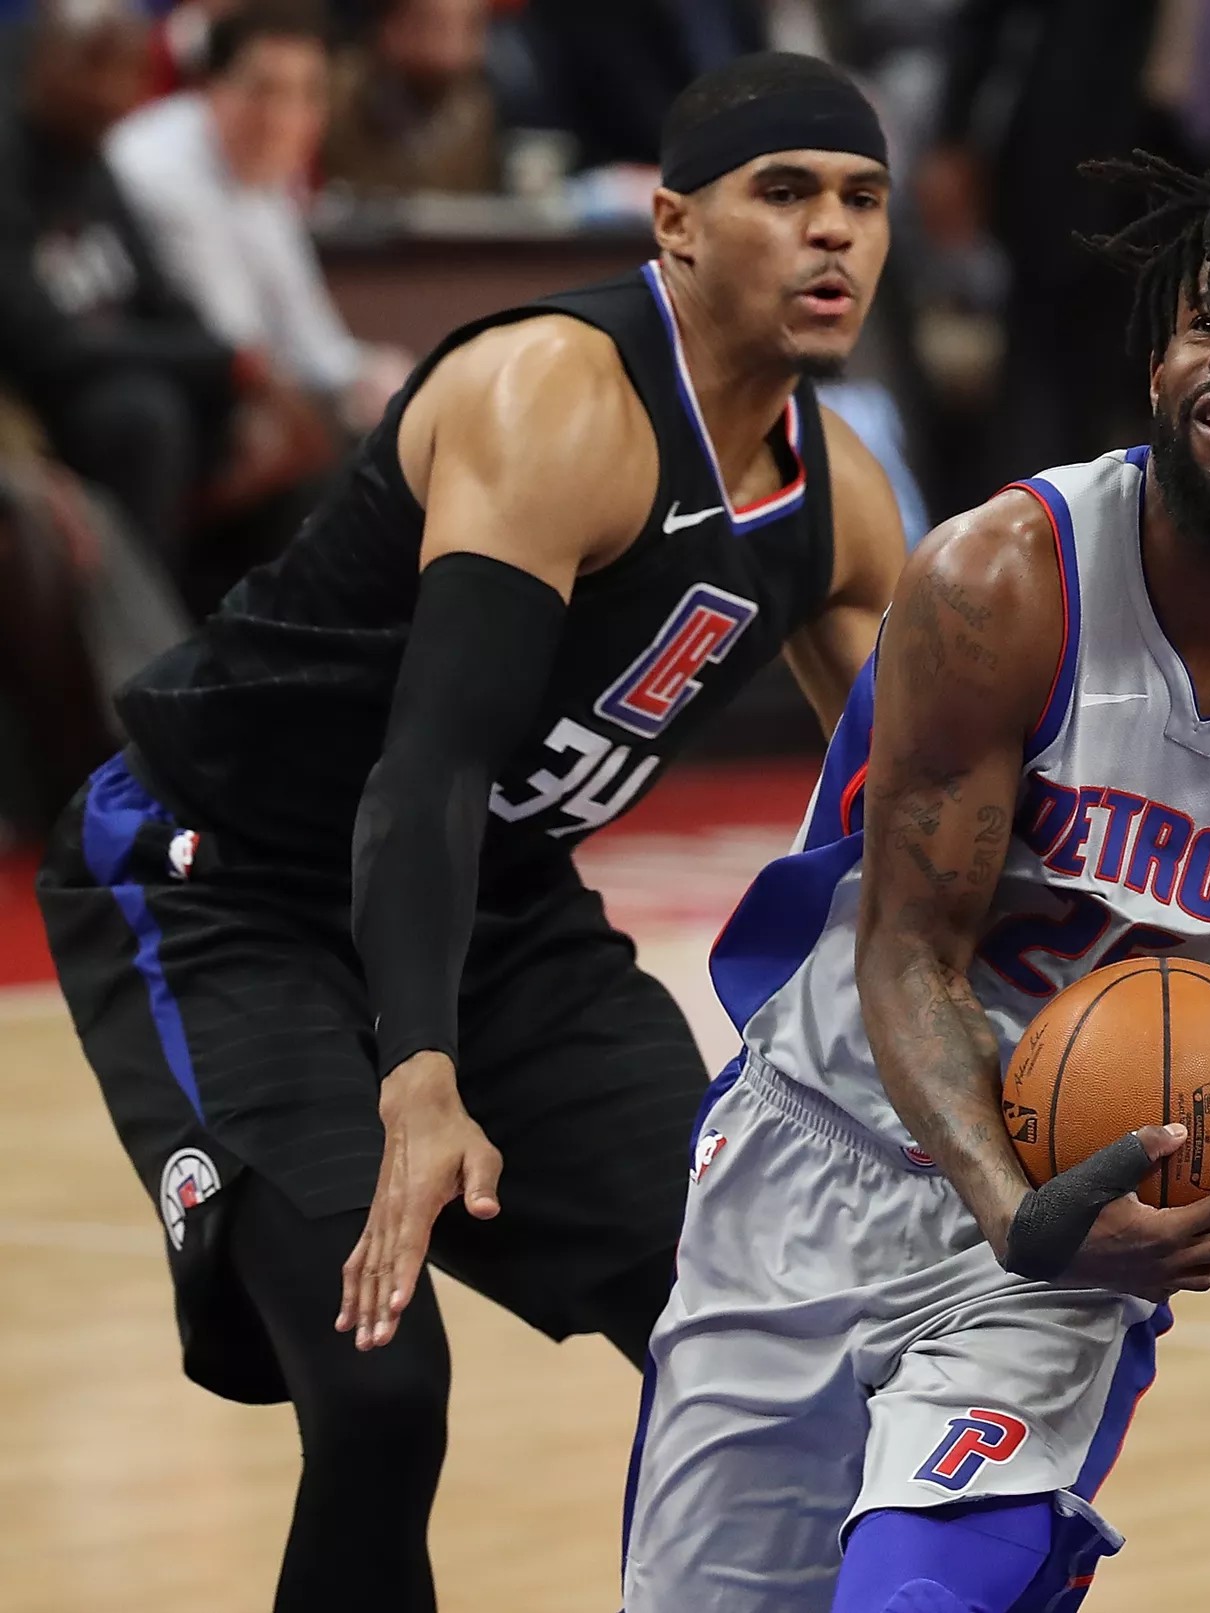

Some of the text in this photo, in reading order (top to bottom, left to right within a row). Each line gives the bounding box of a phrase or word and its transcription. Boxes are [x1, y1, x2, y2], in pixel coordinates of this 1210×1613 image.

[488, 717, 660, 838] 34
[1027, 1118, 1036, 1143] NBA
[1195, 1115, 1203, 1161] GAME BALL
